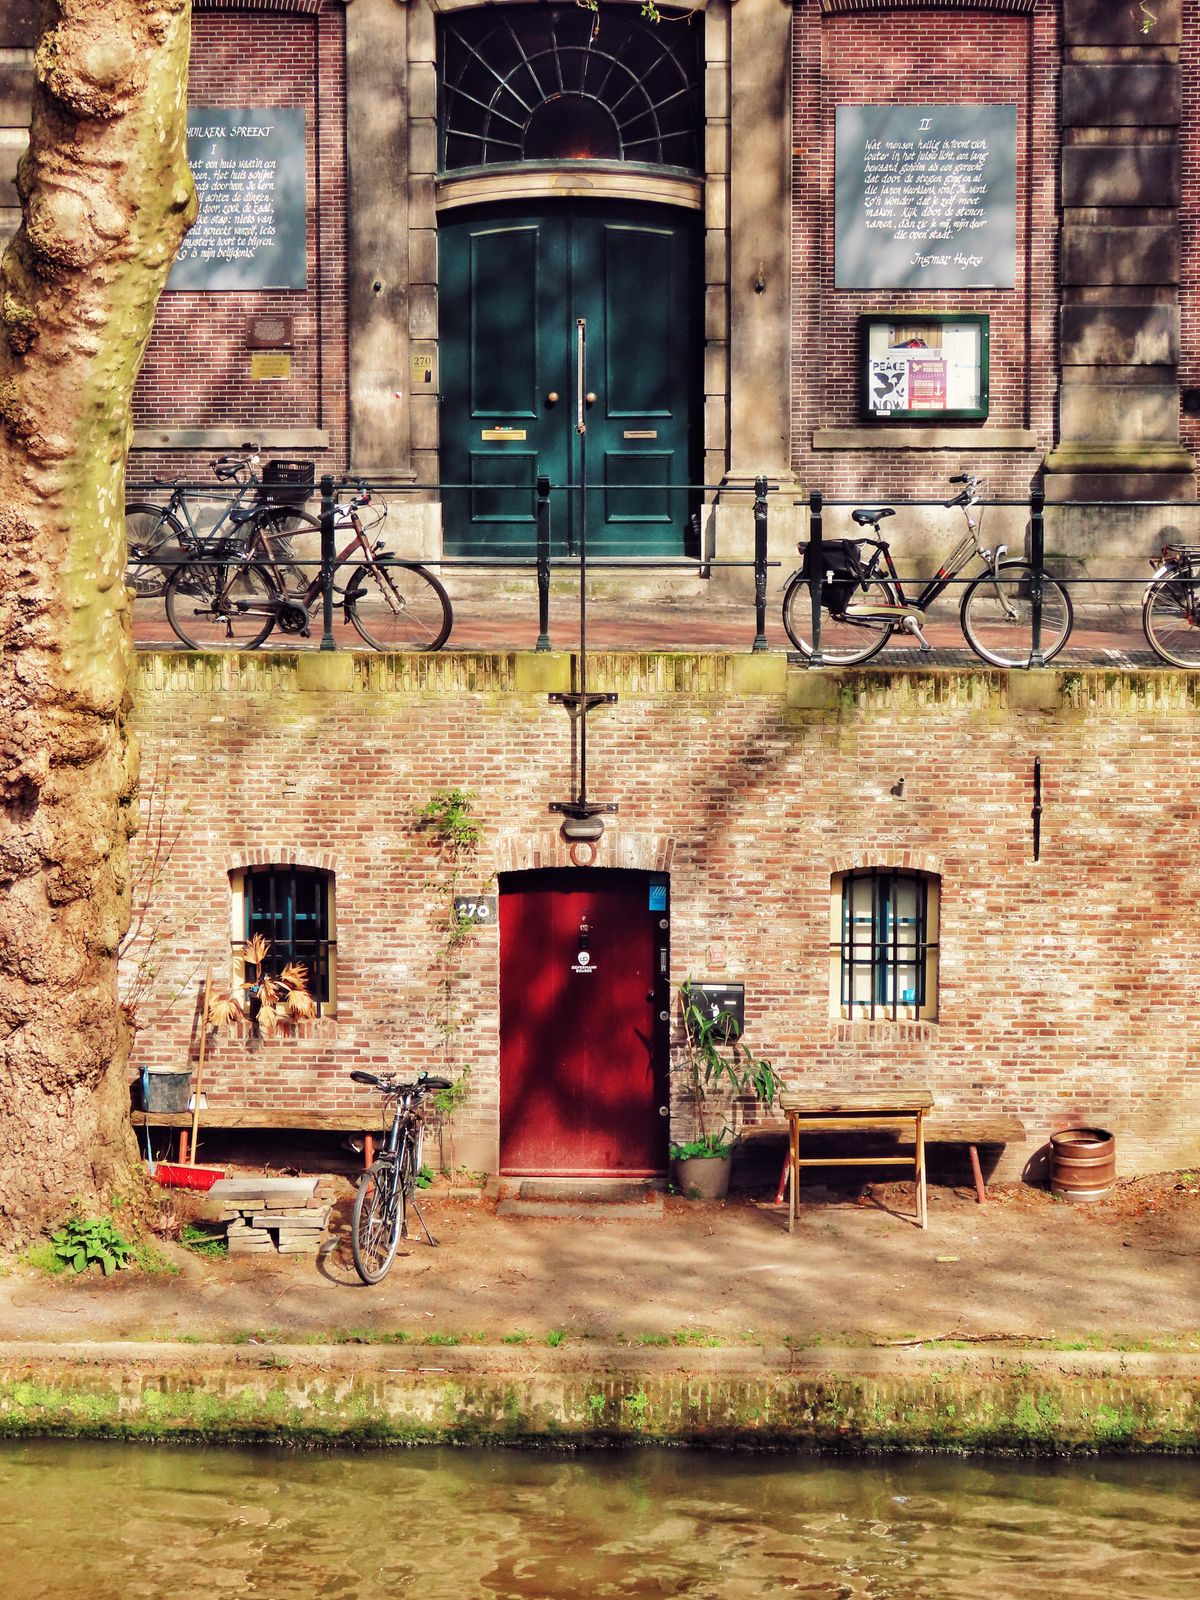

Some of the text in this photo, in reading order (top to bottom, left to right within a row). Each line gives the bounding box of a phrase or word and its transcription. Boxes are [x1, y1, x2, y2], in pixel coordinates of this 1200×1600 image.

[230, 126, 274, 137] SPREEKT
[865, 139, 881, 150] Wat
[884, 142, 914, 150] mensen
[891, 151, 900, 161] in
[902, 151, 916, 161] het
[956, 152, 969, 160] een
[970, 150, 989, 163] lang
[205, 160, 218, 169] een
[219, 158, 236, 168] huis
[264, 160, 277, 168] een
[864, 161, 899, 172] bewaard
[928, 162, 939, 171] als
[940, 163, 953, 172] een
[953, 162, 984, 175] gerucht
[213, 169, 229, 180] Het
[230, 169, 246, 179] huis
[247, 169, 274, 181] schijnt
[864, 173, 880, 183] dat
[881, 173, 901, 183] door
[904, 173, 914, 183] de
[915, 173, 942, 185] stegen
[962, 175, 972, 183] en
[972, 174, 983, 182] al
[257, 180, 276, 190] kern
[864, 184, 878, 194] die
[879, 185, 901, 196] jaren
[205, 192, 230, 202] achter
[231, 192, 242, 202] de
[916, 196, 931, 205] dat
[930, 196, 940, 209] je
[940, 195, 958, 208] zelf
[957, 197, 981, 205] moet
[221, 203, 241, 214] zoek
[242, 203, 251, 213] de
[921, 206, 943, 217] door
[944, 207, 954, 216] de
[955, 207, 986, 216] stenen
[234, 215, 255, 224] niets
[257, 215, 274, 224] van
[898, 218, 915, 228] dan
[203, 225, 232, 237] spreekt
[893, 229, 954, 241] die open staat.
[216, 236, 237, 246] hoort
[237, 237, 246, 246] te
[191, 247, 198, 257] is
[910, 252, 984, 270] Ingmar Heytze
[413, 356, 431, 365] 270
[872, 361, 905, 371] PEACE
[872, 400, 905, 410] NOW
